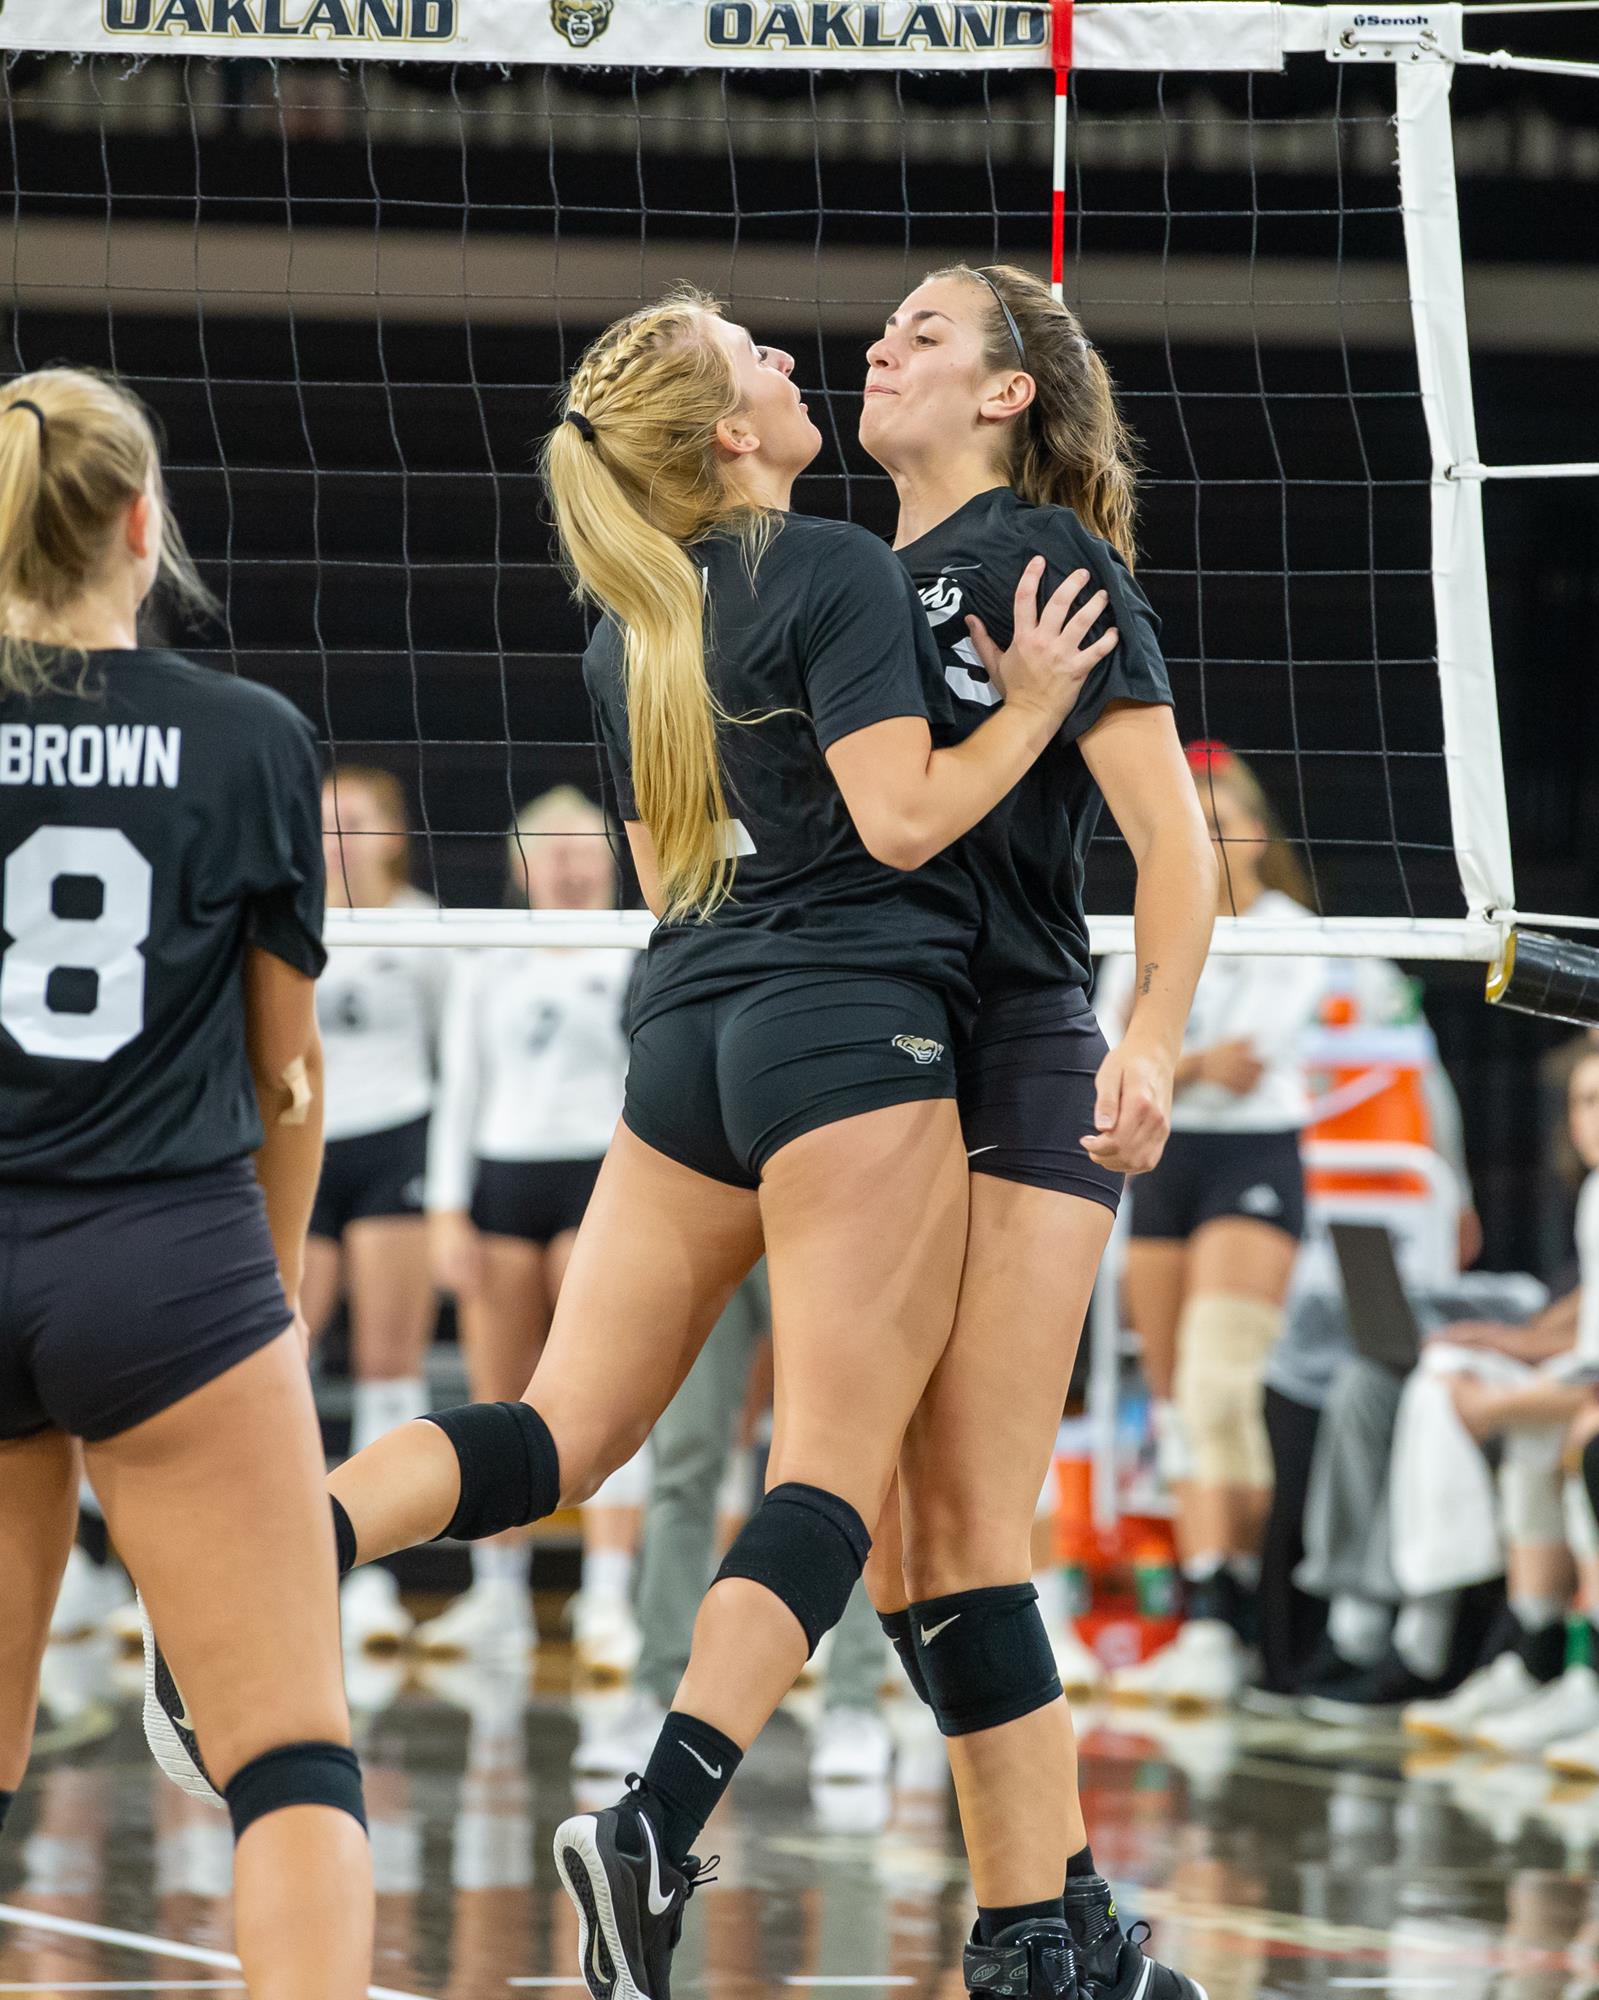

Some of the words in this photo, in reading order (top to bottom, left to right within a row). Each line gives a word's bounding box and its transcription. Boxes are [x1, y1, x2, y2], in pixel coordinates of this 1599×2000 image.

[102, 0, 457, 42] OAKLAND
[705, 2, 1049, 51] OAKLAND
[1367, 15, 1429, 26] Senoh
[0, 723, 181, 788] BROWN
[0, 825, 152, 1062] 8
